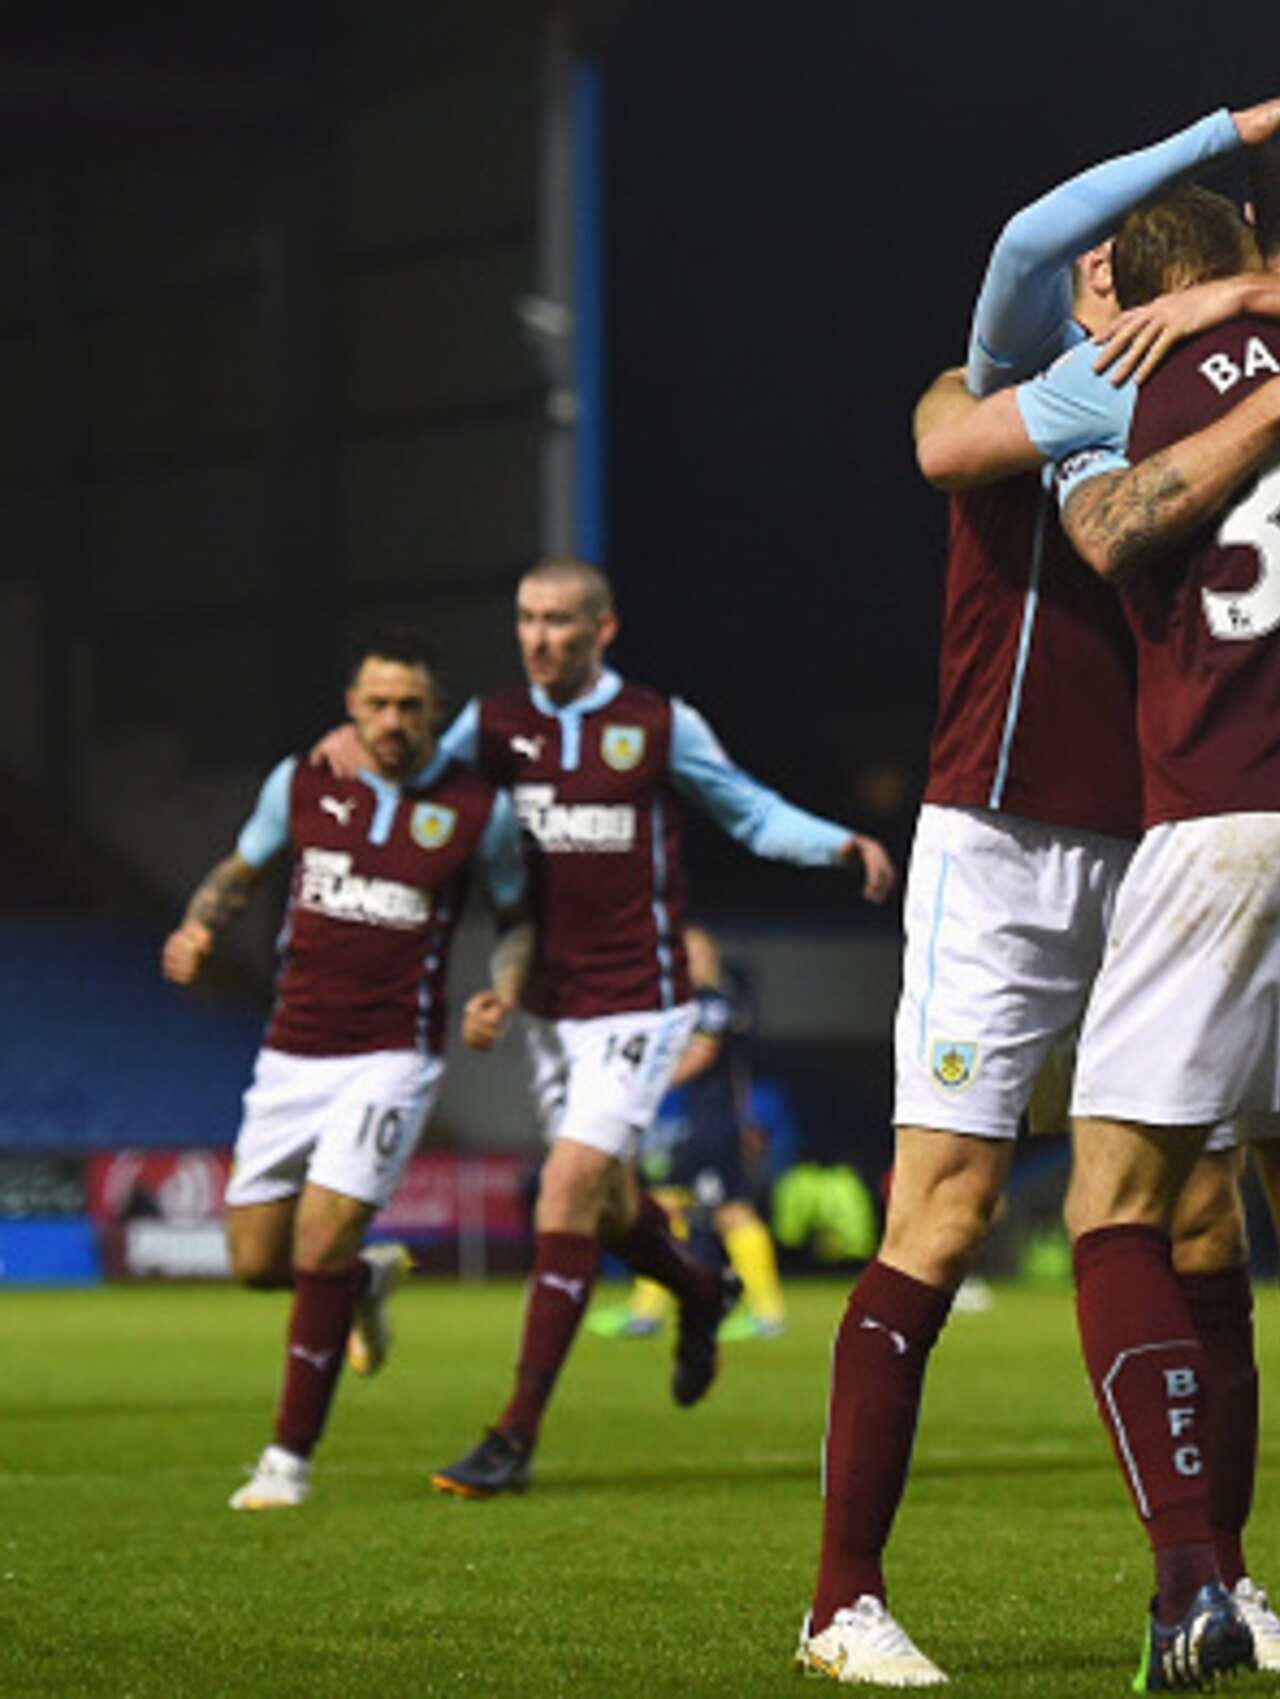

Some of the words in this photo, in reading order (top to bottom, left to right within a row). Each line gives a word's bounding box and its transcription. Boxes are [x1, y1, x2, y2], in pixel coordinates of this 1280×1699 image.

[603, 1032, 647, 1070] 14
[355, 1103, 403, 1158] 10
[1163, 1368, 1203, 1476] BFC
